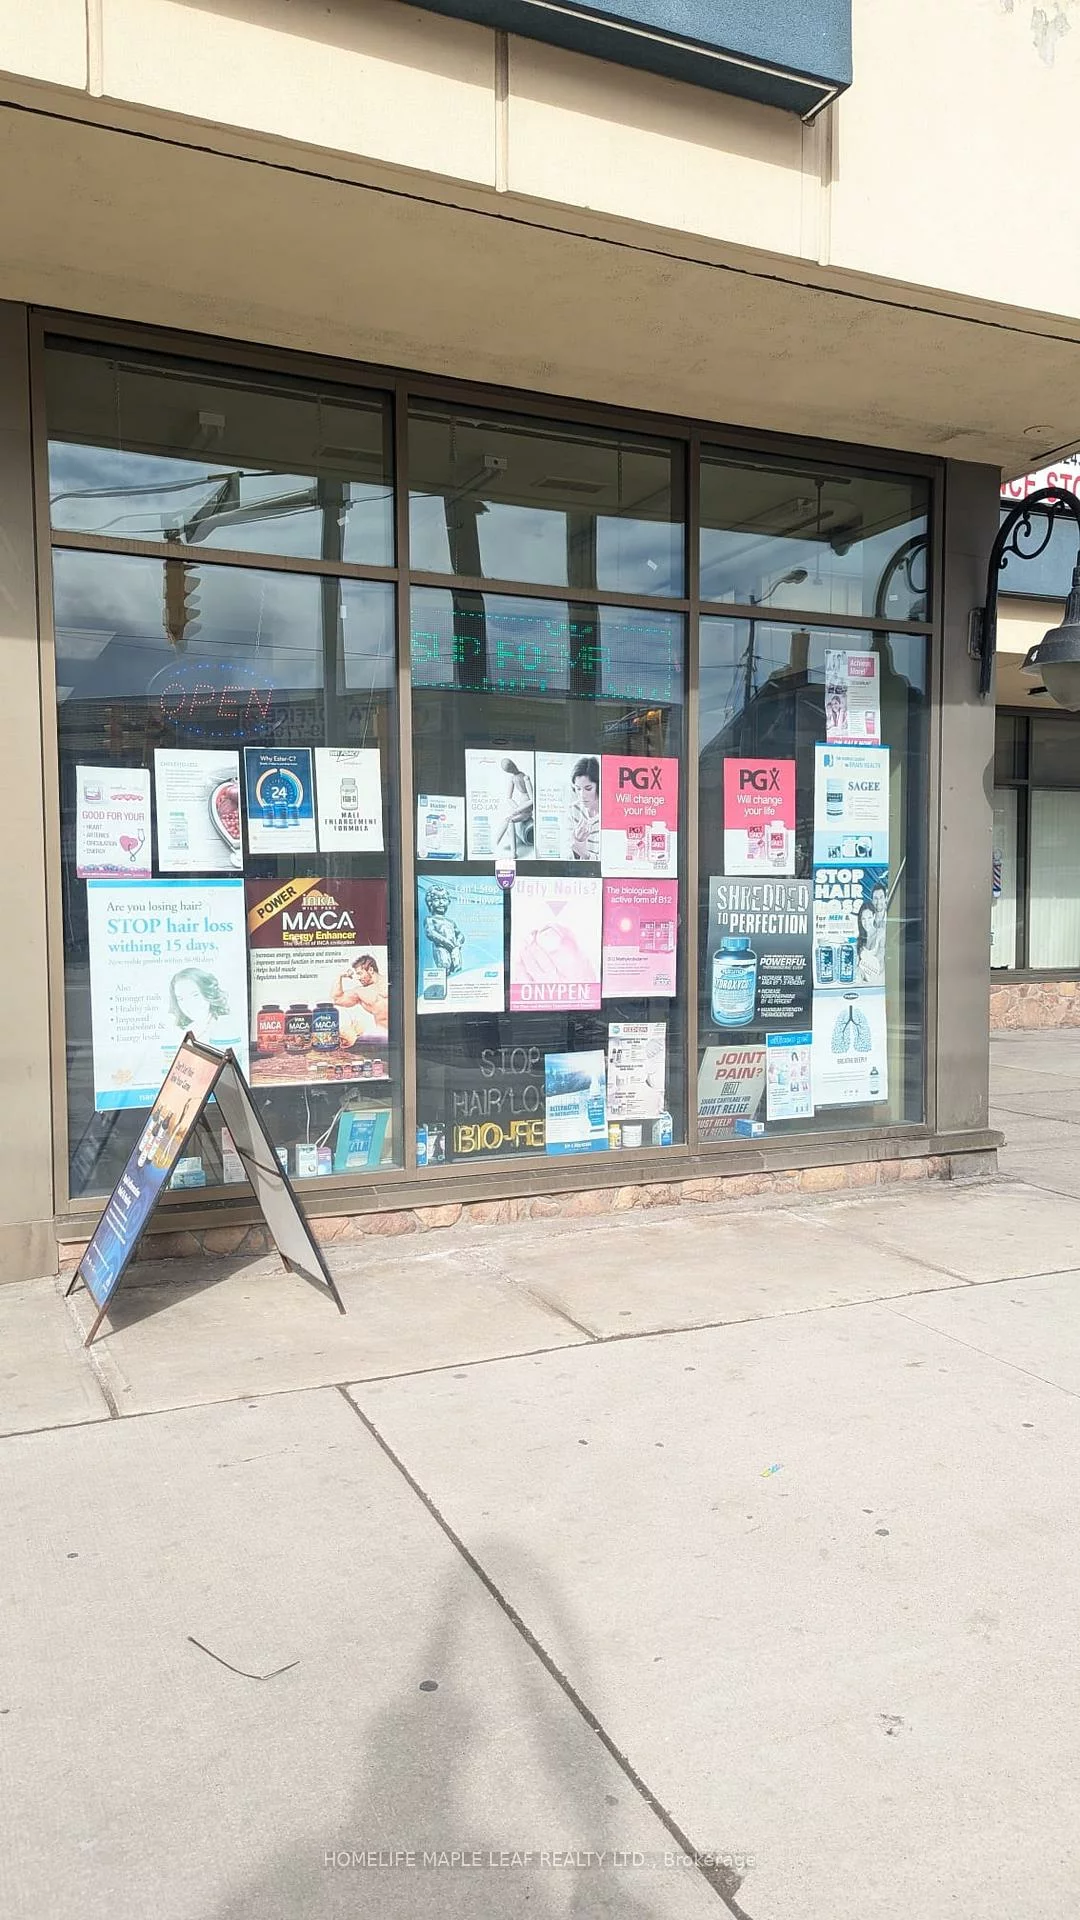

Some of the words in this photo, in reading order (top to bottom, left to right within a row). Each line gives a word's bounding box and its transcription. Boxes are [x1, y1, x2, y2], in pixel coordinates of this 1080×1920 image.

[160, 683, 273, 719] OPEN
[619, 766, 662, 790] PGX
[739, 768, 780, 790] PGX
[271, 786, 288, 798] 24
[848, 782, 880, 791] SAGEE
[616, 794, 632, 803] Will
[633, 794, 665, 806] change
[737, 795, 752, 804] Will
[752, 795, 782, 806] change
[82, 810, 105, 820] GOOD
[106, 811, 122, 821] FOR
[124, 812, 144, 822] YOUR
[624, 808, 643, 816] your
[644, 806, 657, 815] life
[744, 807, 763, 816] your
[764, 806, 776, 816] life
[815, 868, 864, 884] STOP
[517, 882, 548, 896] Ugly
[554, 881, 598, 894] Nails?
[607, 886, 620, 894] The
[622, 886, 659, 896] biologically
[815, 884, 864, 898] HAIR
[256, 886, 297, 918] POWER
[611, 896, 632, 904] active
[633, 896, 650, 904] form
[650, 896, 658, 904] of
[658, 896, 672, 904] B12
[717, 884, 808, 912] SHREDDED
[107, 902, 124, 912] Are
[128, 904, 146, 914] you
[148, 901, 178, 914] losing
[180, 900, 202, 911] hair?
[107, 918, 161, 934] STOP
[166, 918, 200, 933] hair
[204, 916, 234, 932] loss
[282, 911, 354, 930] MACA
[717, 912, 728, 924] TO
[730, 913, 808, 934] PERFECTION
[283, 932, 314, 942] Energy
[316, 931, 356, 940] Enhancer
[108, 940, 161, 956] withing
[166, 939, 182, 952] 15
[186, 938, 218, 954] days.
[760, 958, 806, 966] POWERFUL
[520, 984, 590, 1001] ONYPEN
[260, 1022, 282, 1030] MACA
[289, 1022, 310, 1030] MACA
[480, 1046, 540, 1078] STOP
[716, 1051, 766, 1065] JOINT
[715, 1068, 763, 1080] PAIN?
[453, 1088, 502, 1118] HAIR
[510, 1084, 545, 1114] LO
[724, 1104, 749, 1113] RELIEF
[714, 1118, 732, 1127] HELP
